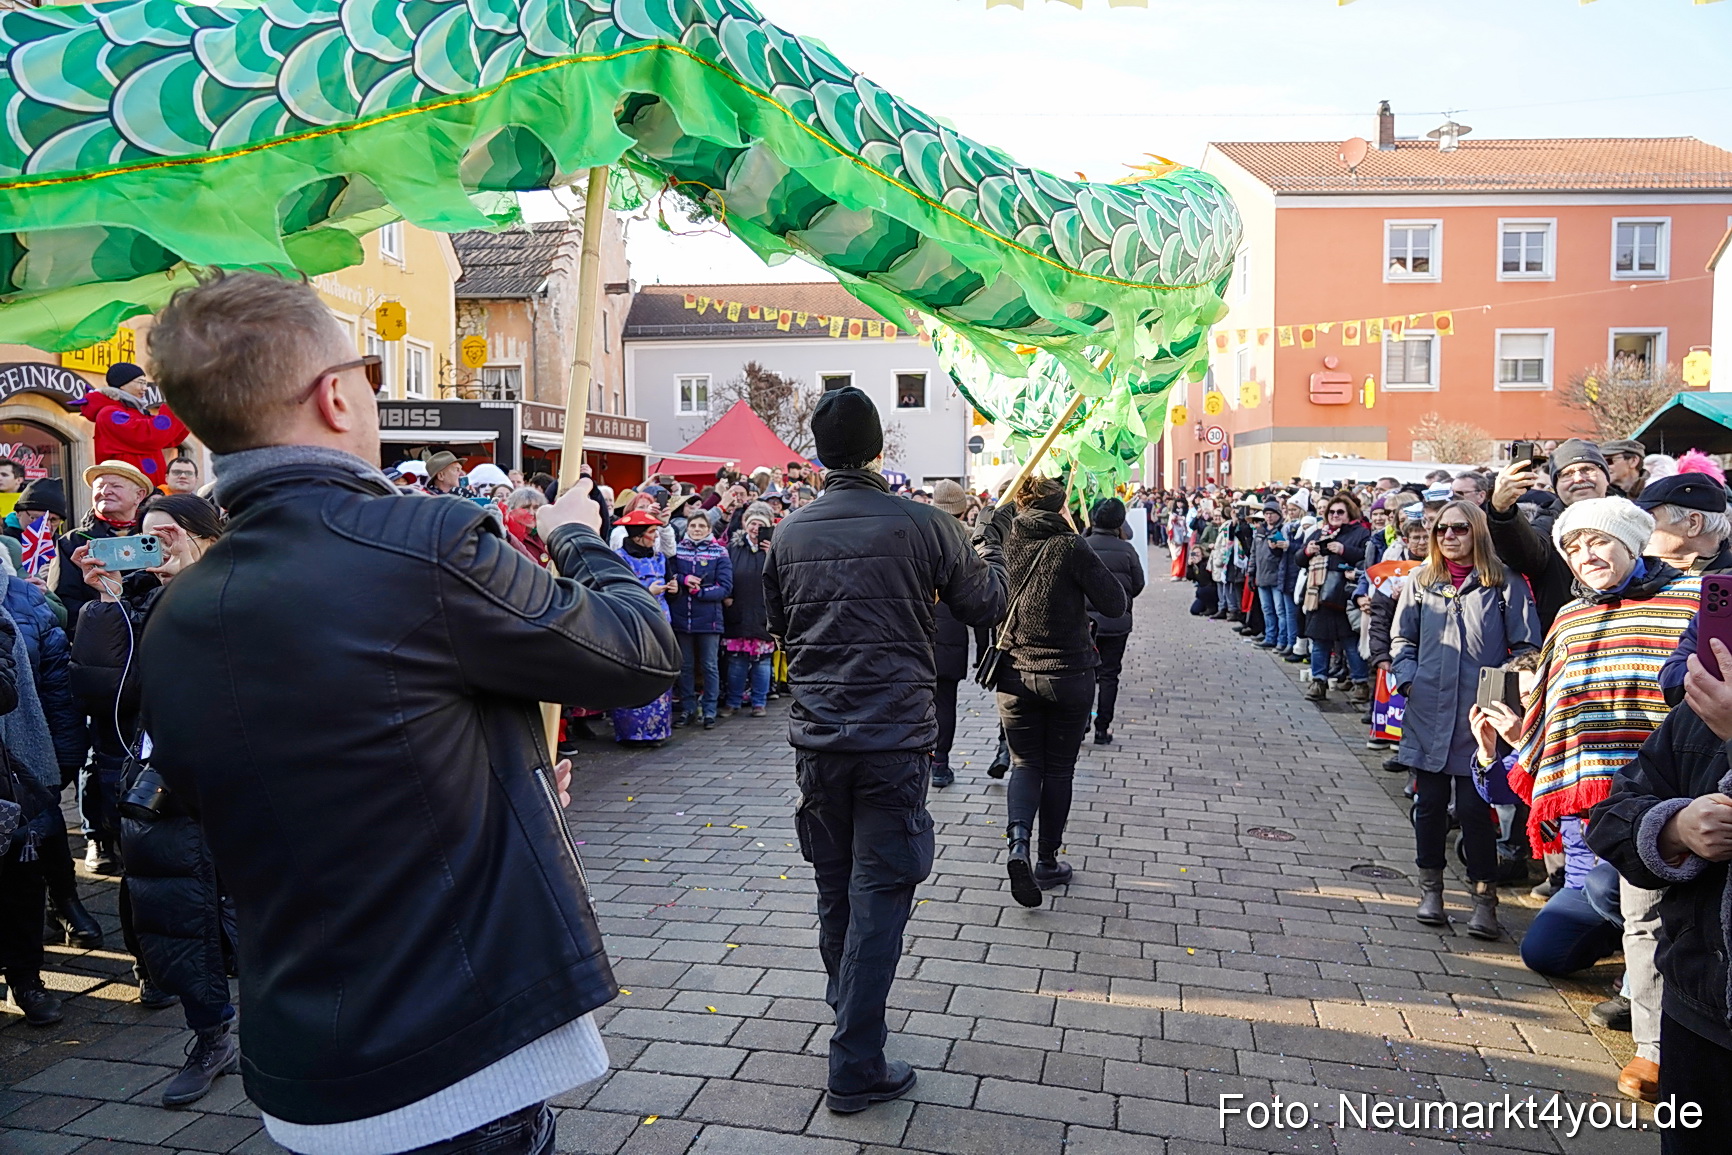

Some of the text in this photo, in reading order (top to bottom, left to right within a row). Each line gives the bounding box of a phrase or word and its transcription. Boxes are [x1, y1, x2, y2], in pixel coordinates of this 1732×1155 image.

[0, 365, 87, 400] FEINKOS
[379, 408, 441, 427] MBISS
[540, 411, 642, 438] IMBS KRÄMER
[1209, 431, 1221, 440] 30
